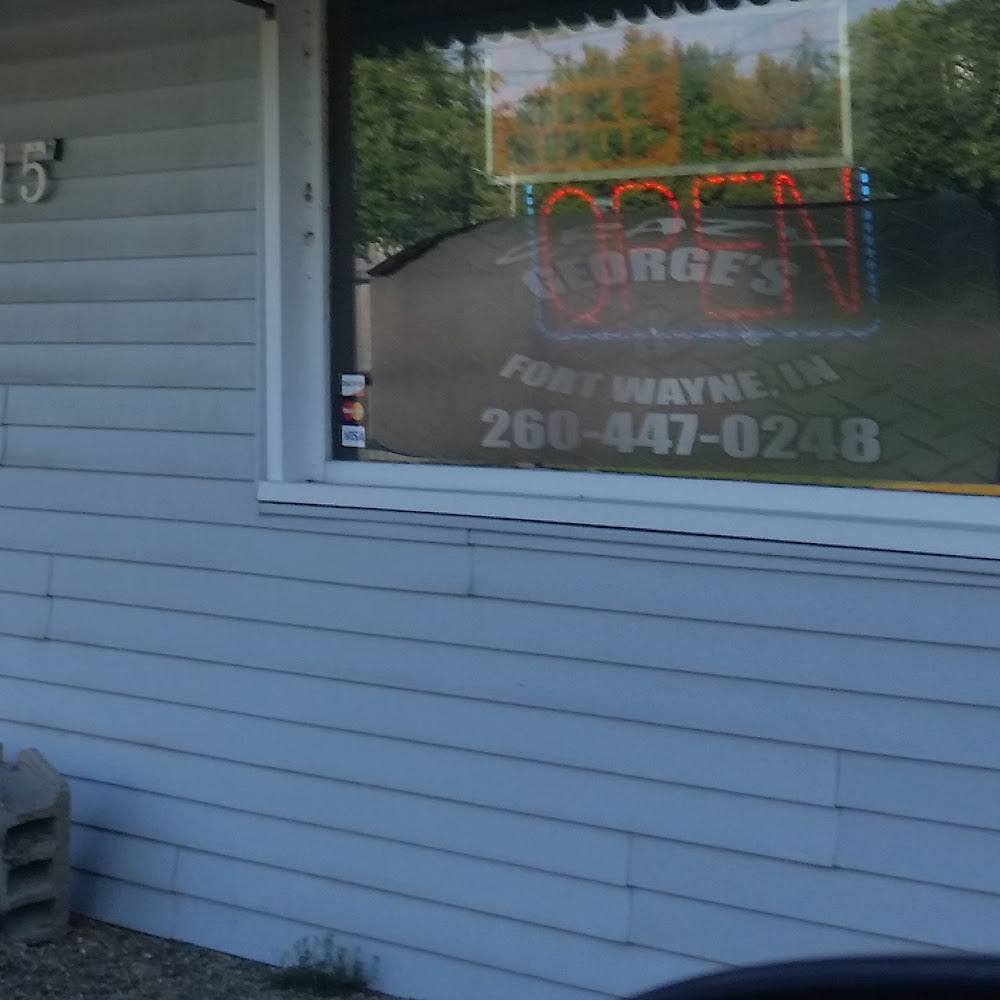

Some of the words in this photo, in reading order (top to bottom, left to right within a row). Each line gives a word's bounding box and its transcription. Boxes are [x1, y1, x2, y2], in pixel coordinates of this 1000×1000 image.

[542, 168, 860, 323] OPEN
[498, 353, 603, 399] FORT
[778, 353, 841, 391] IN
[480, 408, 881, 464] 260-447-0248
